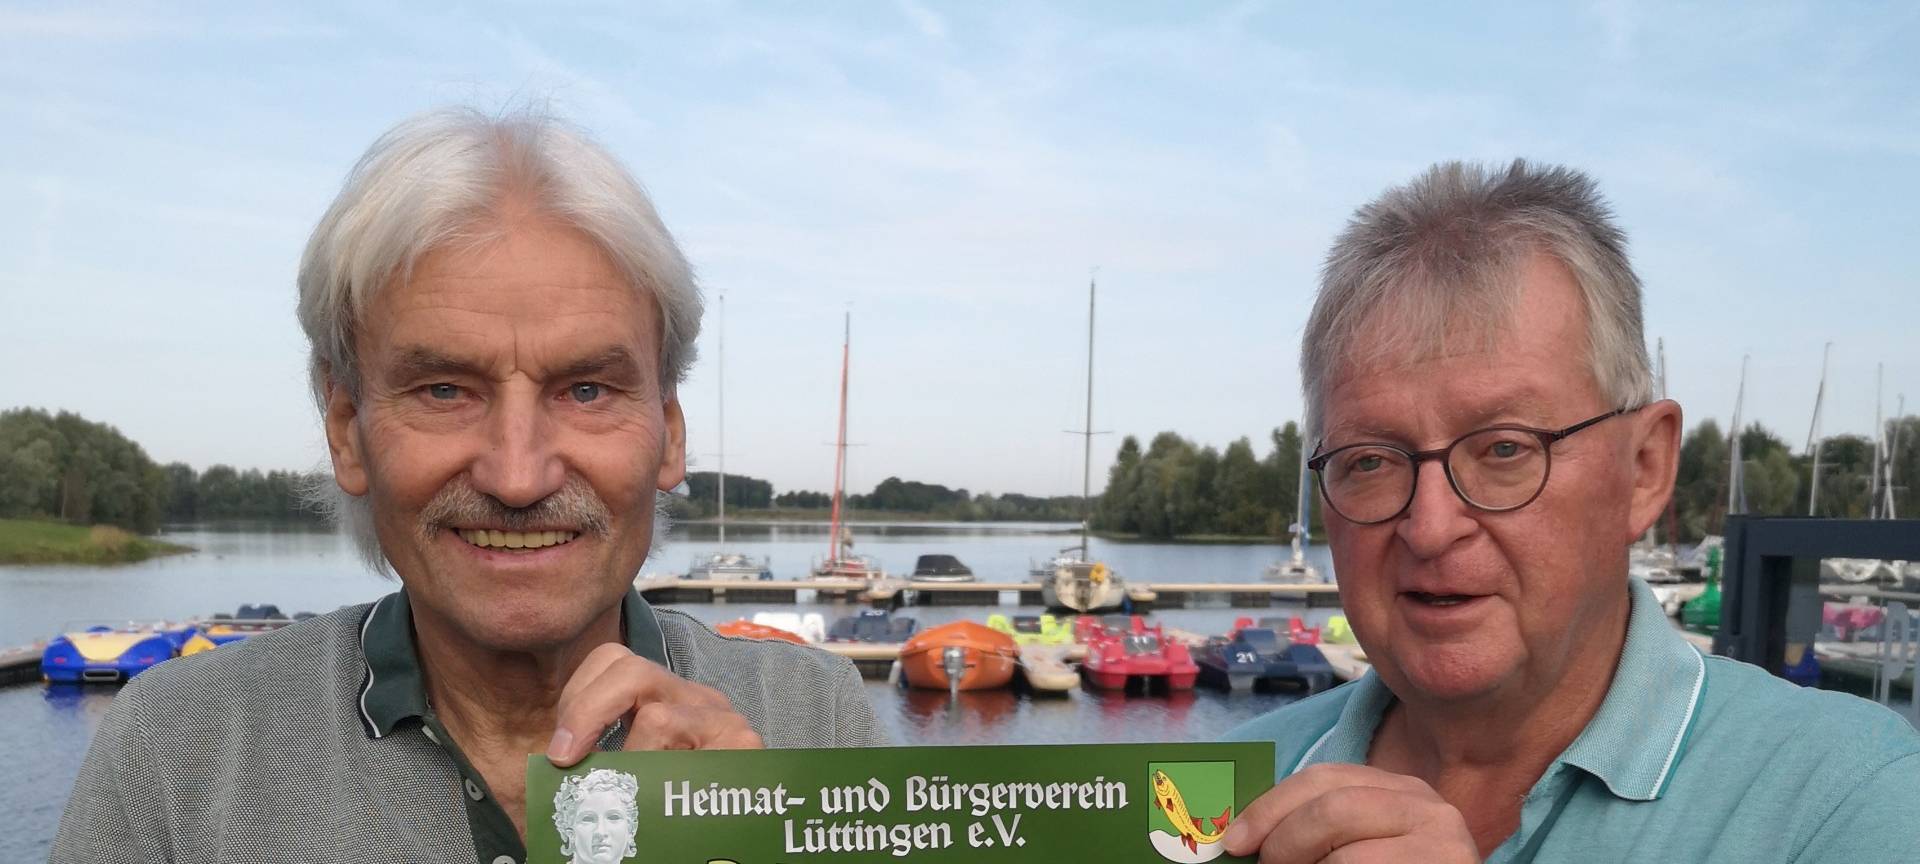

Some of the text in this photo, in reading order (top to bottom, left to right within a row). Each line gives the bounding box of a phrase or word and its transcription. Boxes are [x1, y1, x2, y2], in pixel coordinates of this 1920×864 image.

[1236, 651, 1255, 663] 21
[664, 775, 1129, 817] Heimat- und Bürgerverein
[784, 813, 1026, 857] Lüttingen e.V.
